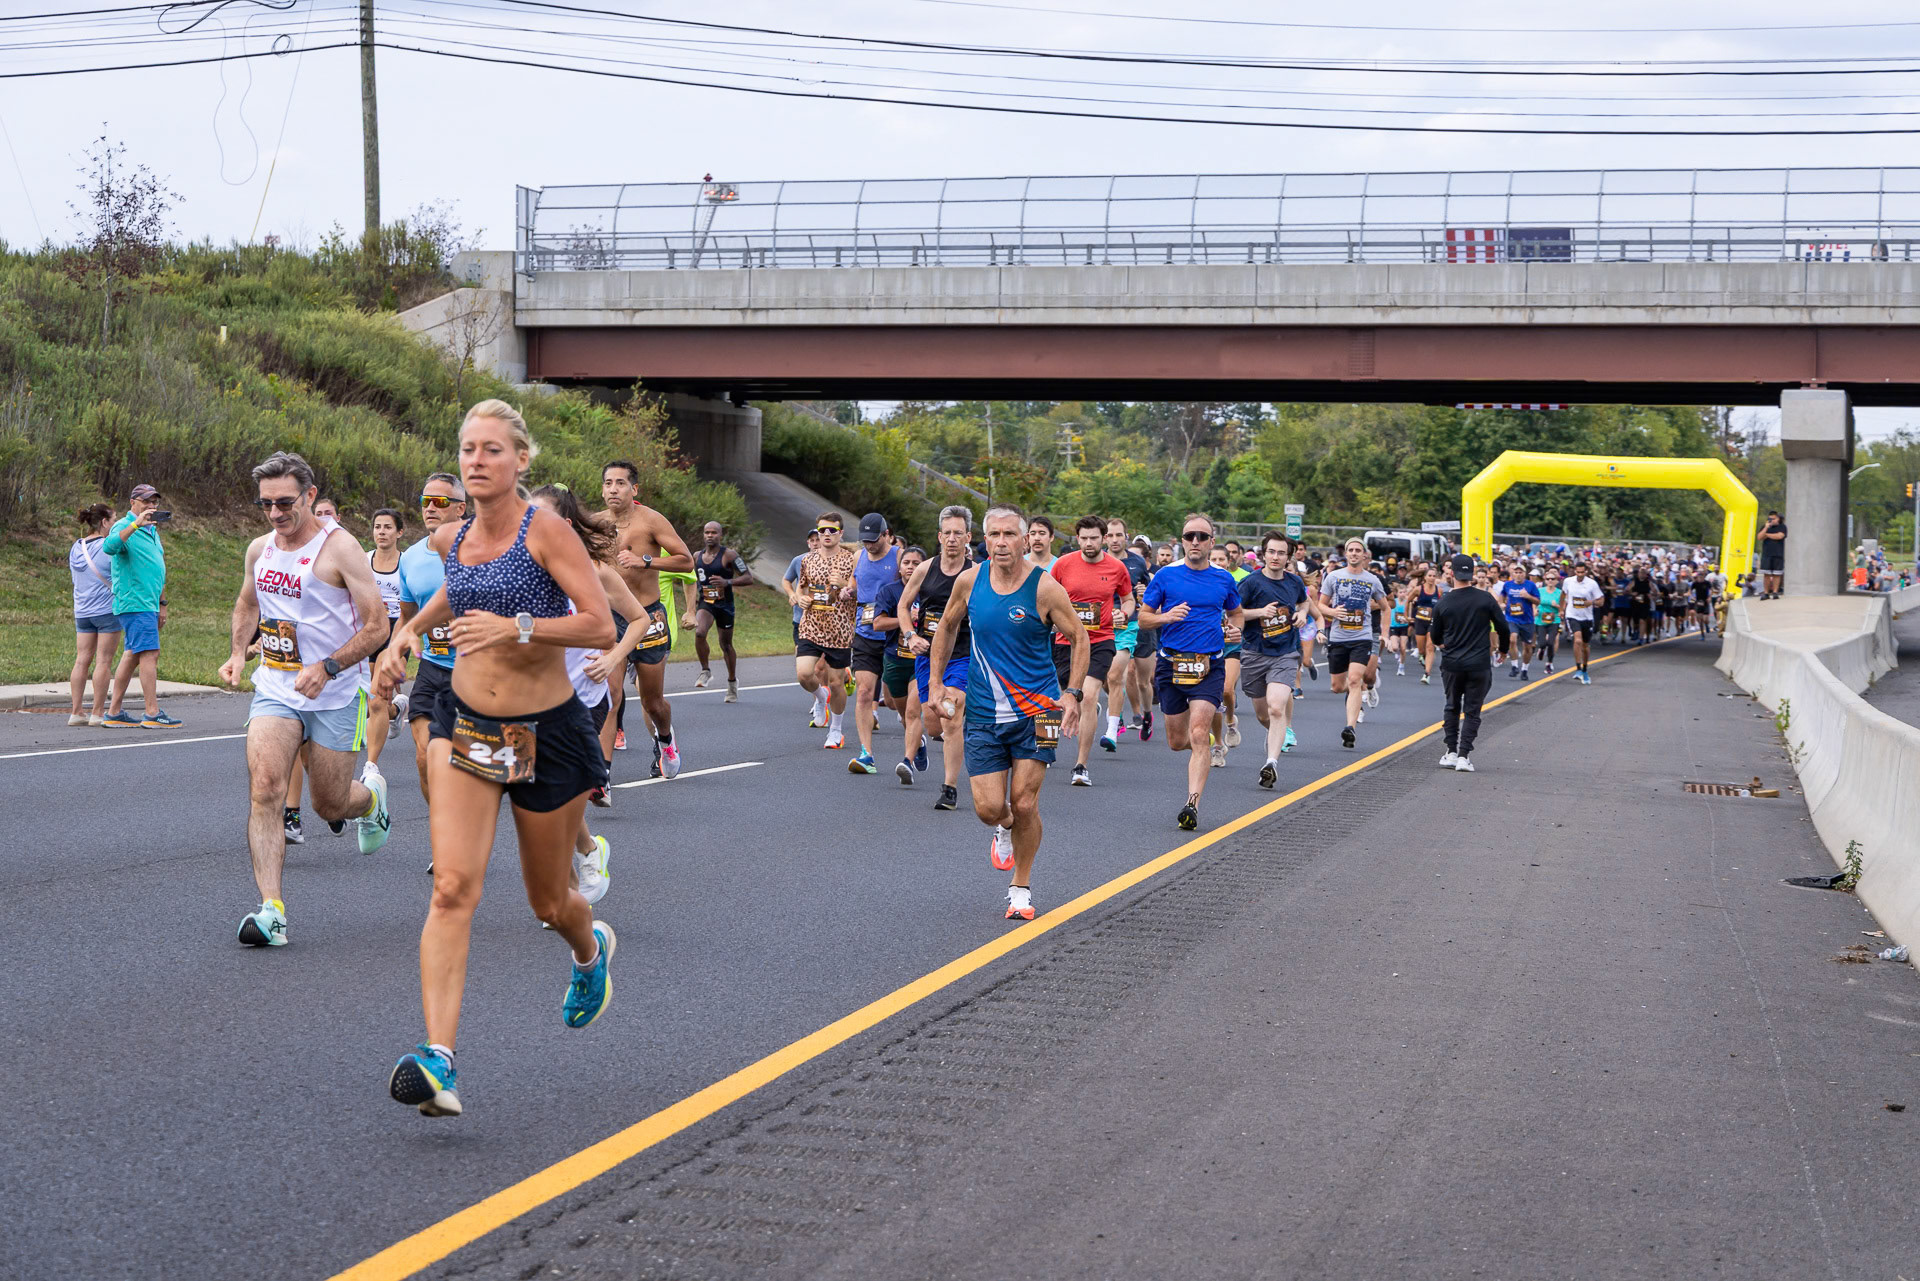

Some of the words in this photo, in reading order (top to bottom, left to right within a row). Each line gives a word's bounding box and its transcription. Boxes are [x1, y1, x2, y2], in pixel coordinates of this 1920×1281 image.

[256, 583, 279, 595] TRACK
[281, 588, 302, 599] CLUB
[813, 592, 829, 601] 23
[1264, 615, 1287, 627] 143
[261, 633, 294, 652] 699
[1177, 662, 1205, 673] 219
[455, 728, 486, 740] CHASE
[469, 742, 517, 767] 24
